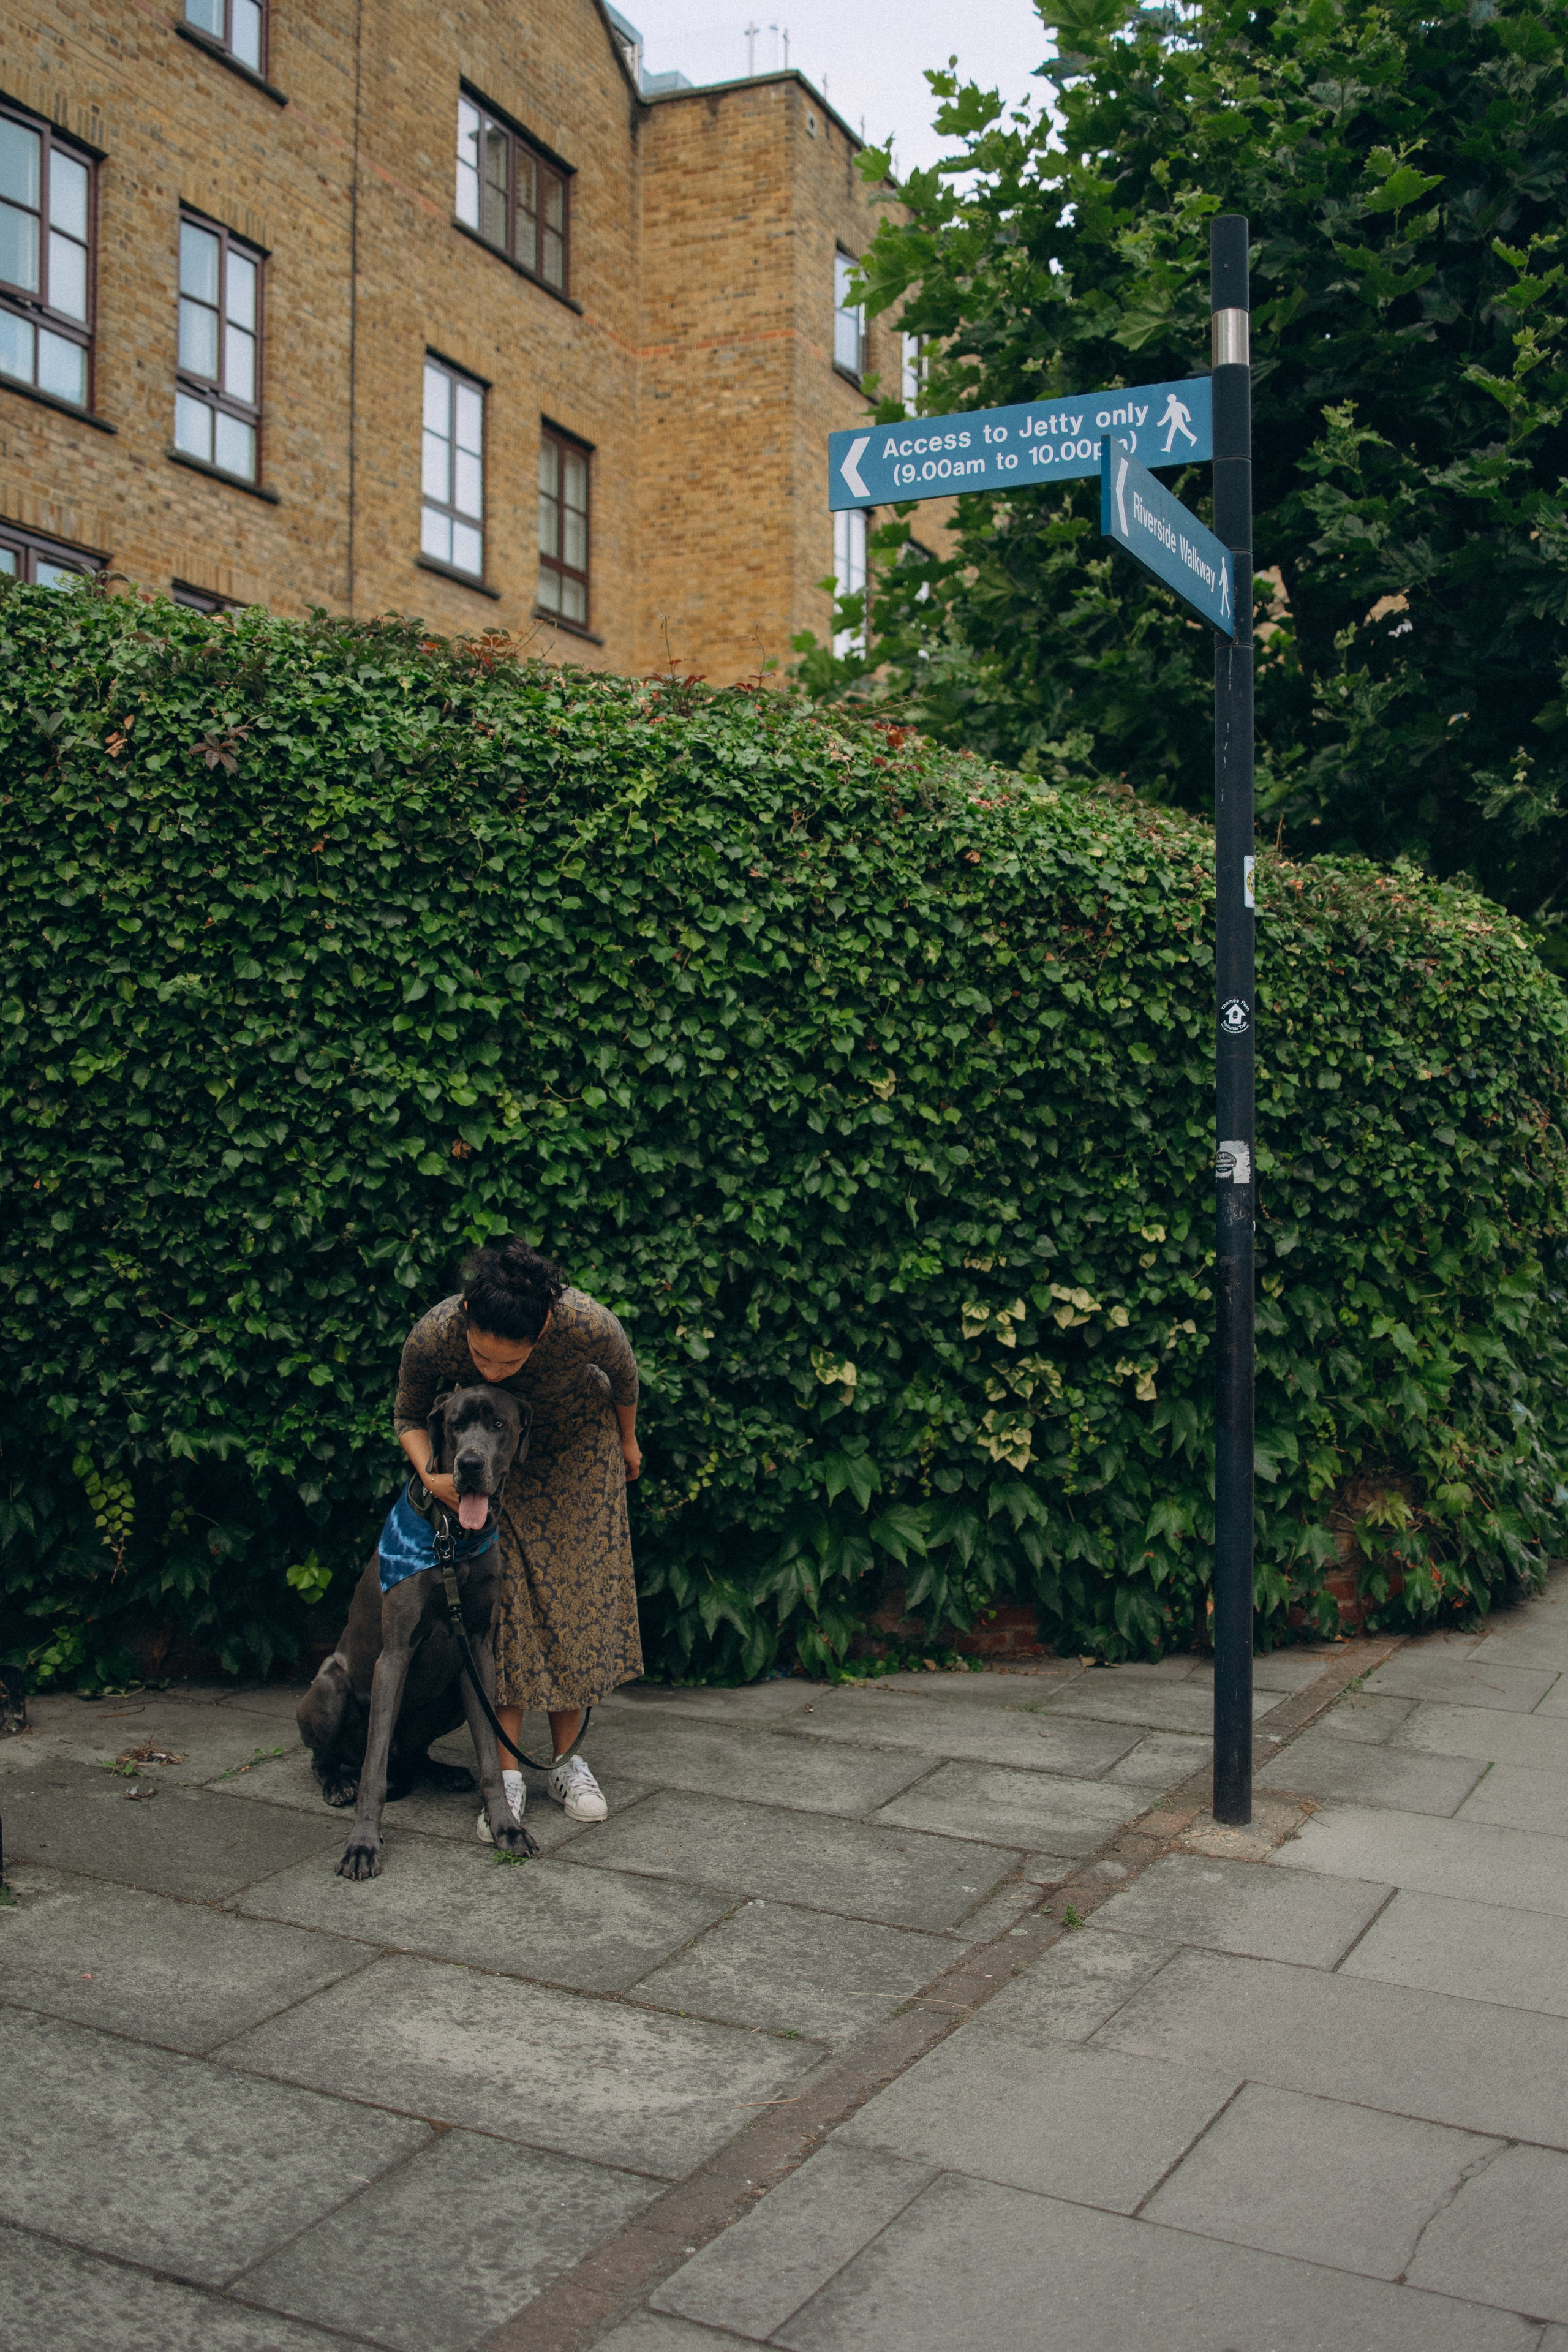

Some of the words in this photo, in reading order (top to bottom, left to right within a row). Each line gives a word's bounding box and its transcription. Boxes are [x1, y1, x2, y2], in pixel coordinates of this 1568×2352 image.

[882, 431, 971, 459] Access
[983, 424, 1008, 443] to
[1019, 413, 1084, 438] Jetty
[1096, 402, 1148, 428] only
[893, 458, 986, 486] (9.00am
[995, 452, 1019, 470] to
[1133, 491, 1177, 554] Riverside
[1179, 533, 1216, 593] Walkway
[1221, 998, 1240, 1010] Thames
[1240, 1000, 1250, 1012] Path
[1223, 1020, 1238, 1031] National
[1238, 1020, 1248, 1029] Trail
